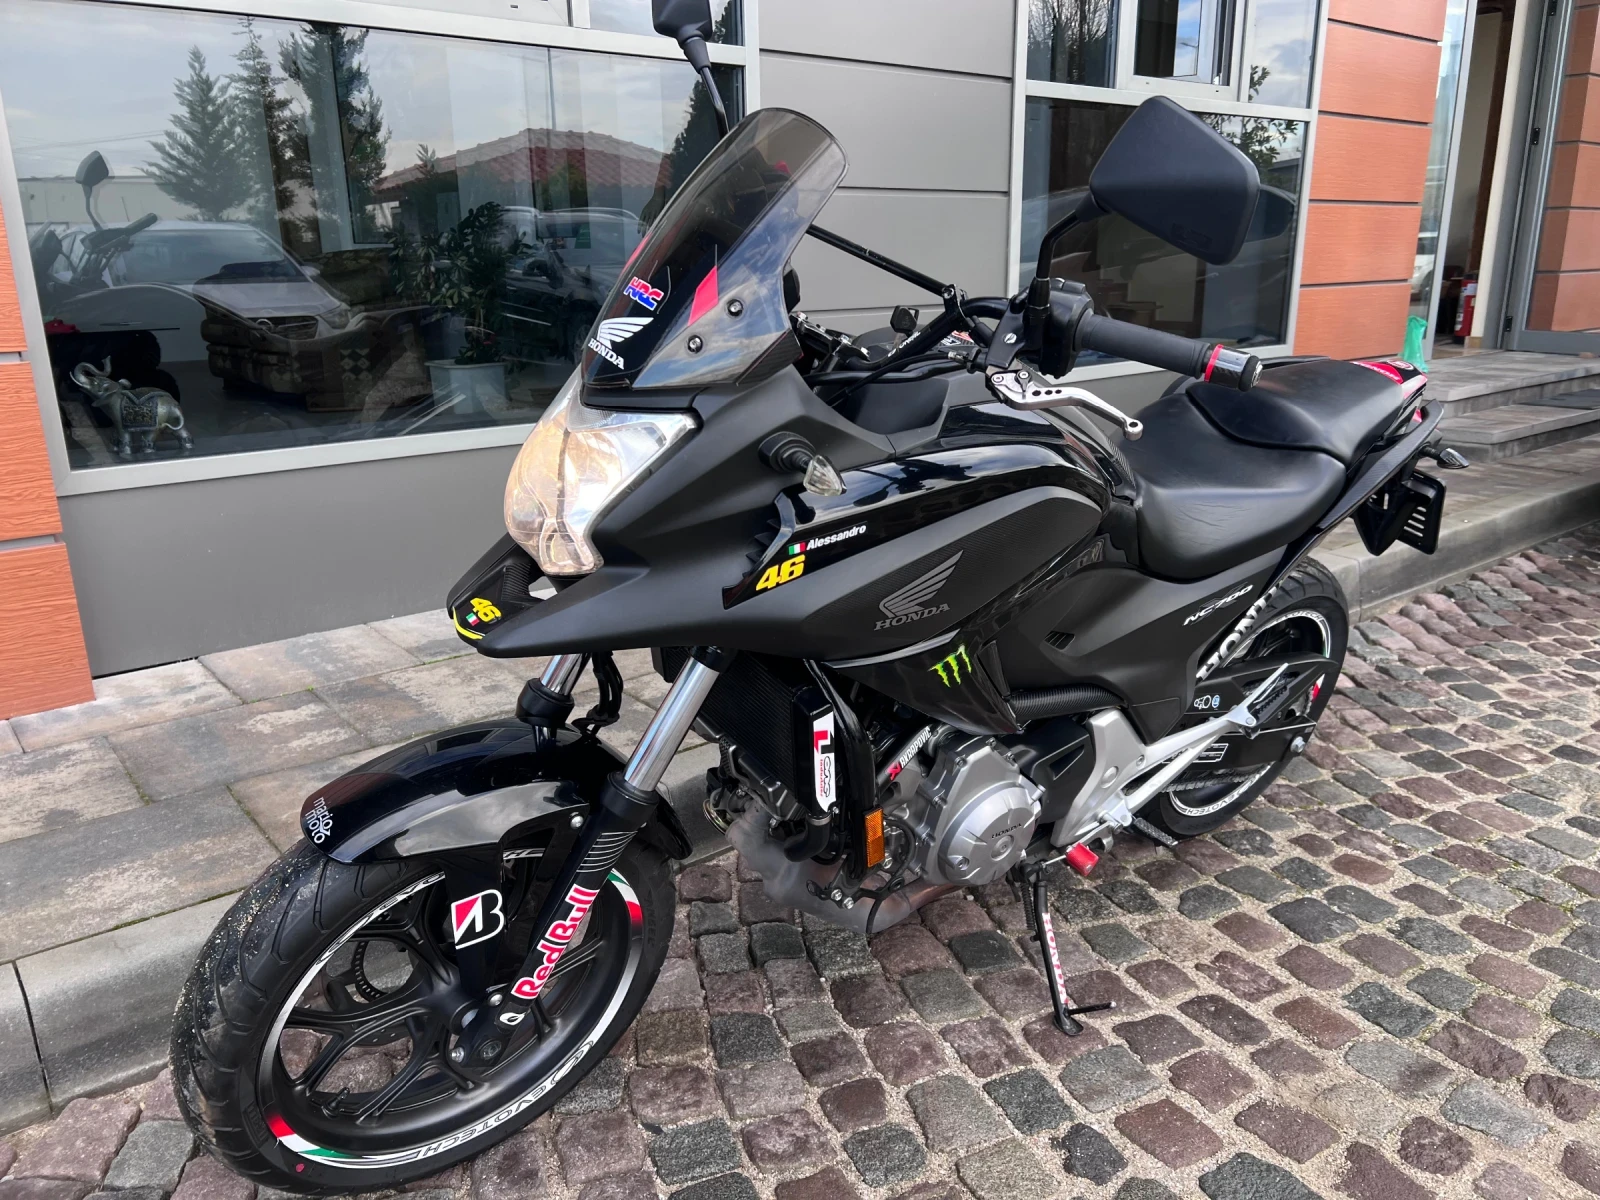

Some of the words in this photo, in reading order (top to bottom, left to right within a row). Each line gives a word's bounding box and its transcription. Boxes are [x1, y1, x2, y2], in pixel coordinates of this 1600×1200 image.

[624, 276, 664, 310] HRC
[587, 337, 624, 370] HONDA
[806, 524, 867, 551] Alessandro
[755, 554, 806, 591] 46
[470, 597, 502, 622] 46
[873, 603, 951, 631] HONDA
[1183, 584, 1254, 626] NC700
[313, 796, 333, 830] mario
[991, 822, 1022, 839] HONDA
[422, 1084, 548, 1157] EVOTECH
